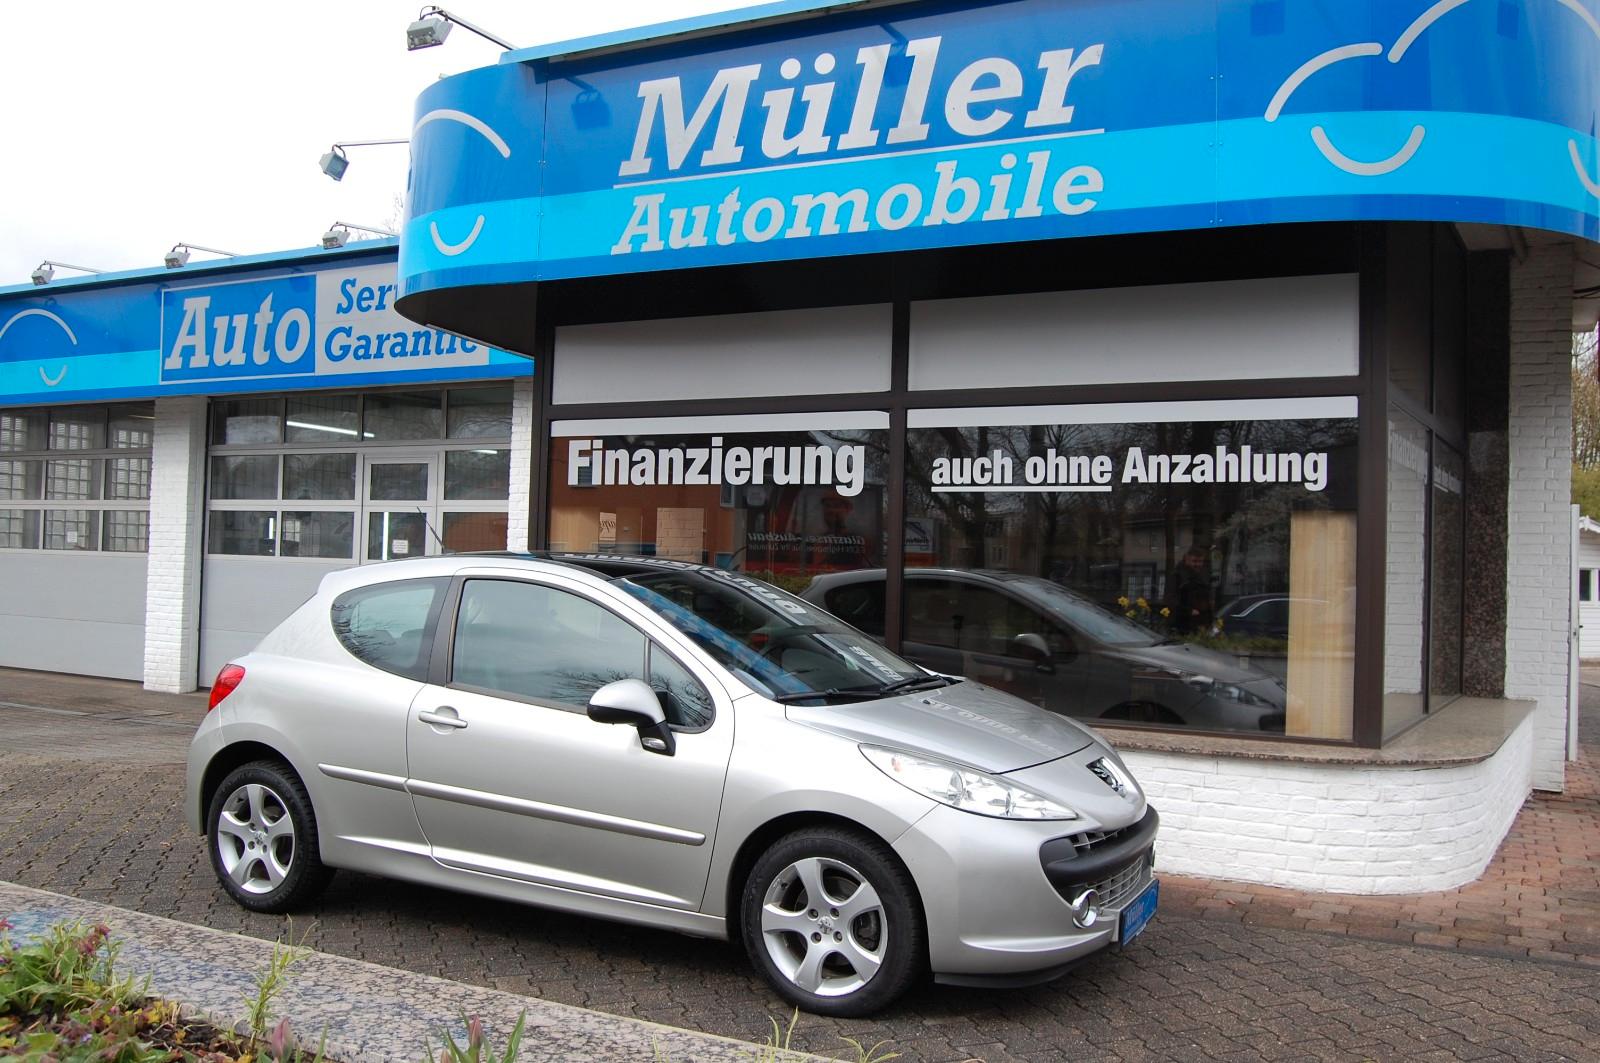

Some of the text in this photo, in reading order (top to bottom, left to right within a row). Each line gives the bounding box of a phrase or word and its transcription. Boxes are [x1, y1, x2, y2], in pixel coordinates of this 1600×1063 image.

[618, 36, 1104, 177] Müller
[610, 150, 1104, 256] Automobile
[164, 291, 311, 370] Auto
[336, 278, 399, 314] Ser
[567, 436, 865, 497] Finanzierung
[931, 445, 1328, 491] auch ohne Anzahlung
